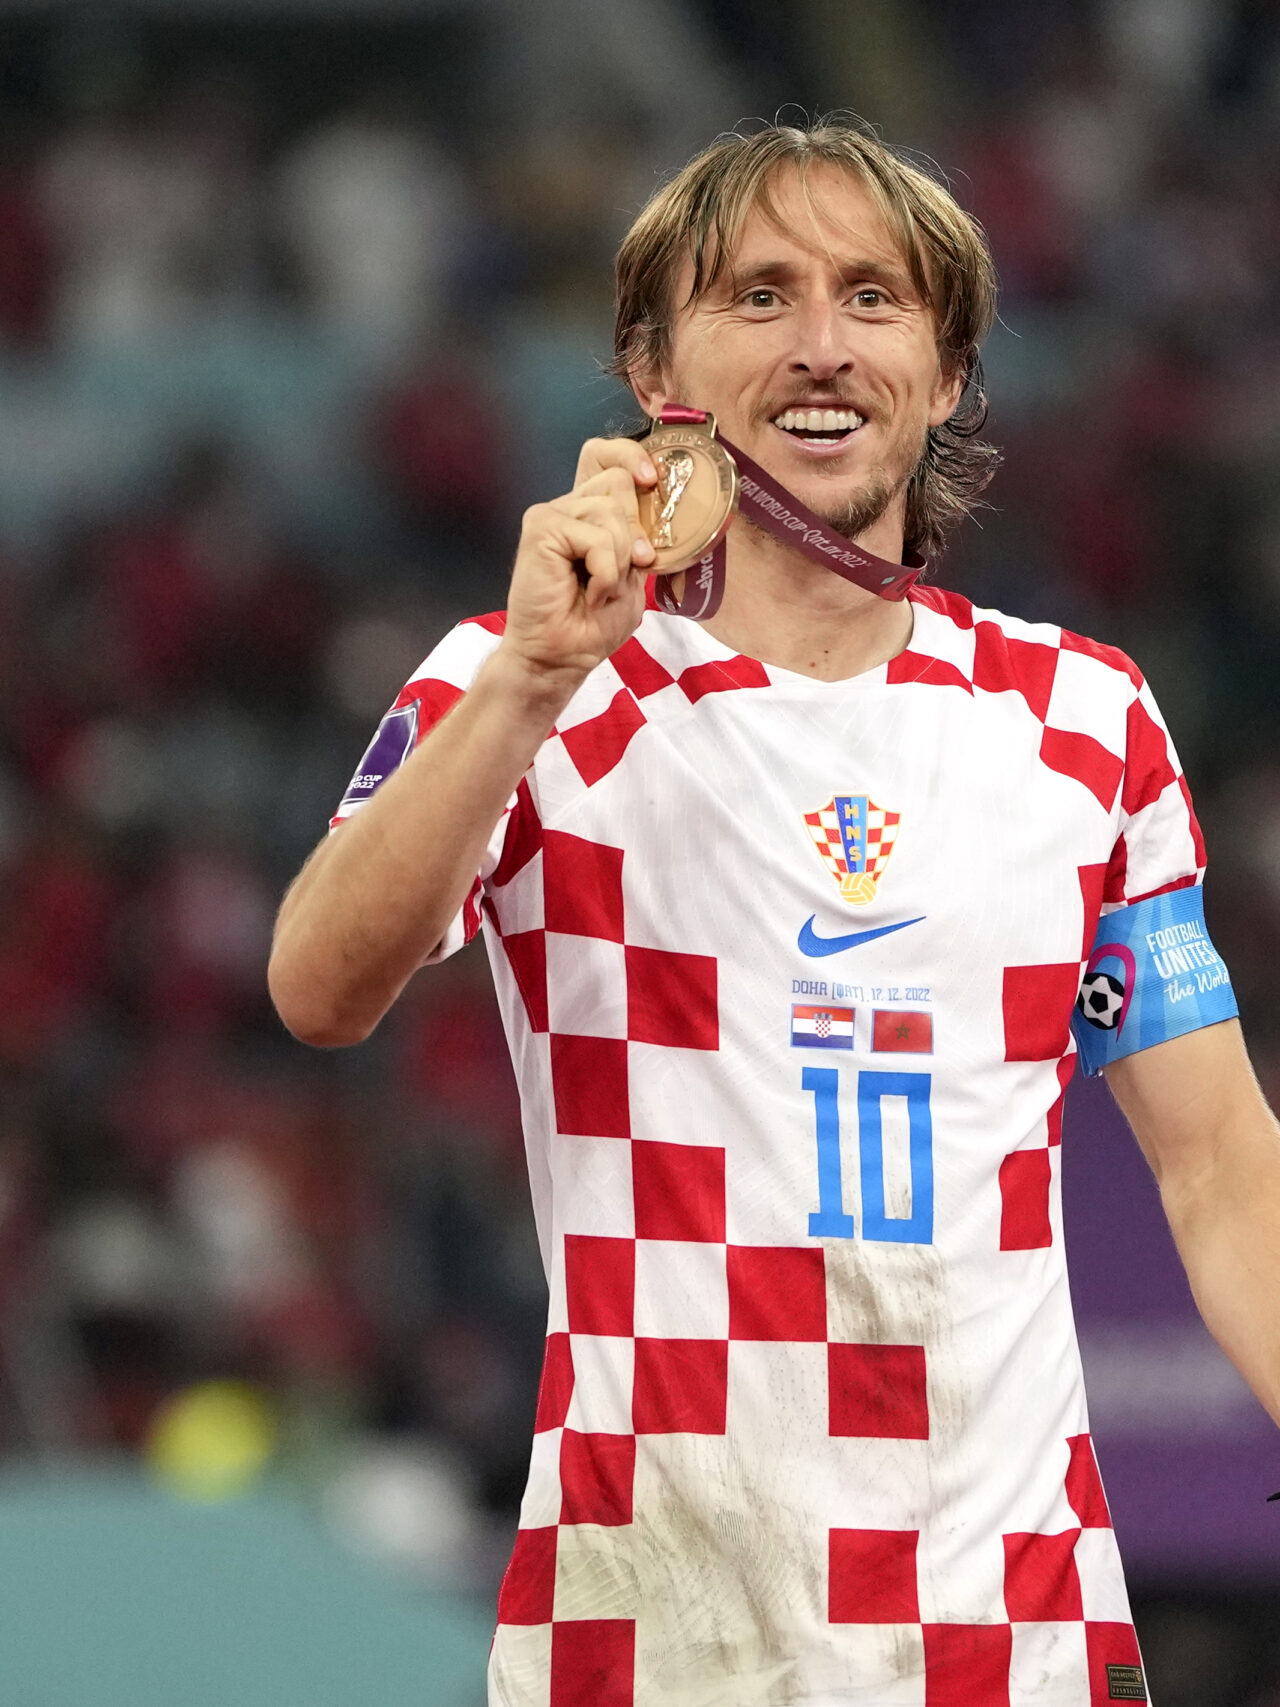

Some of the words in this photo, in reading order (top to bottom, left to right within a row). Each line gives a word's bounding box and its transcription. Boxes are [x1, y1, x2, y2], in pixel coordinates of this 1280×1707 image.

[738, 474, 760, 498] FIFA
[752, 488, 789, 521] WORLD
[782, 511, 808, 533] CUP
[363, 774, 383, 782] CUP
[1145, 919, 1204, 953] FOOTBALL
[1152, 940, 1218, 980] UNITES
[791, 979, 828, 996] DOHA
[1163, 979, 1196, 1004] the
[802, 1066, 934, 1245] 10
